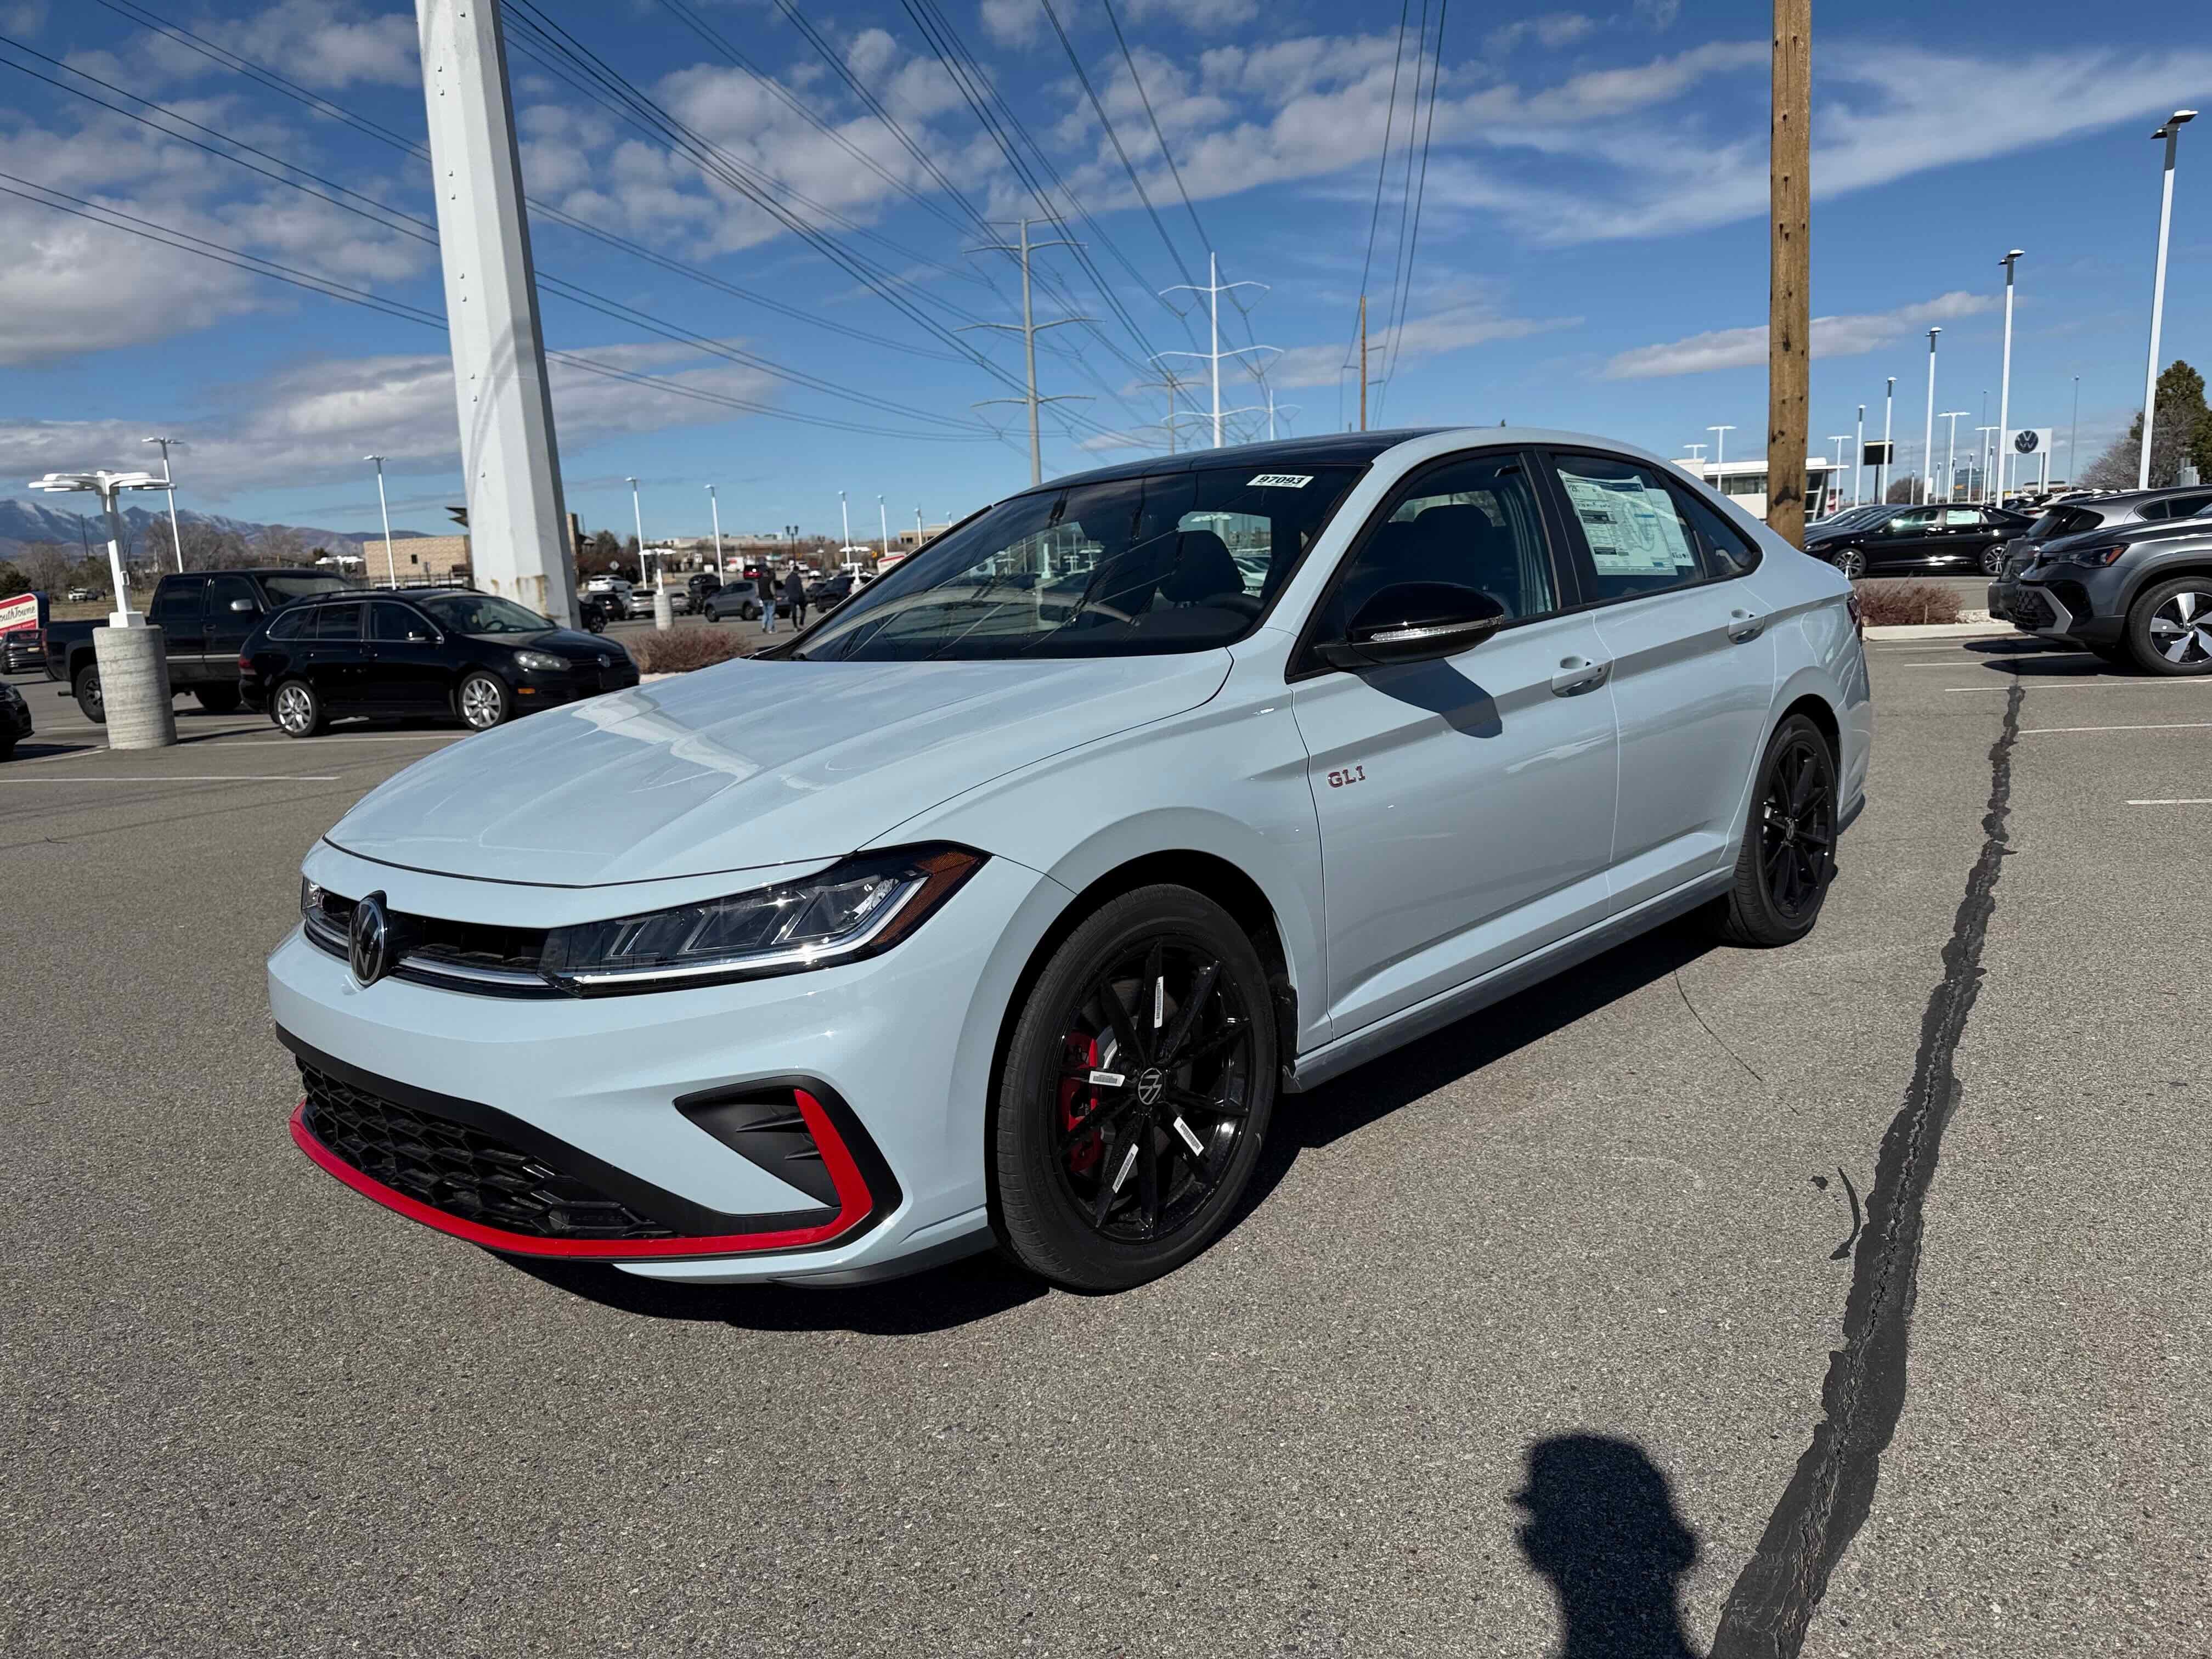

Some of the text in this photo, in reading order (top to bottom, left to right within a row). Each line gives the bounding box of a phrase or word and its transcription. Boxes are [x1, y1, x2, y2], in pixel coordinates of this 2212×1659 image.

[1257, 476, 1305, 484] 97093
[0, 606, 36, 622] outhTowne
[1328, 765, 1365, 788] GLI
